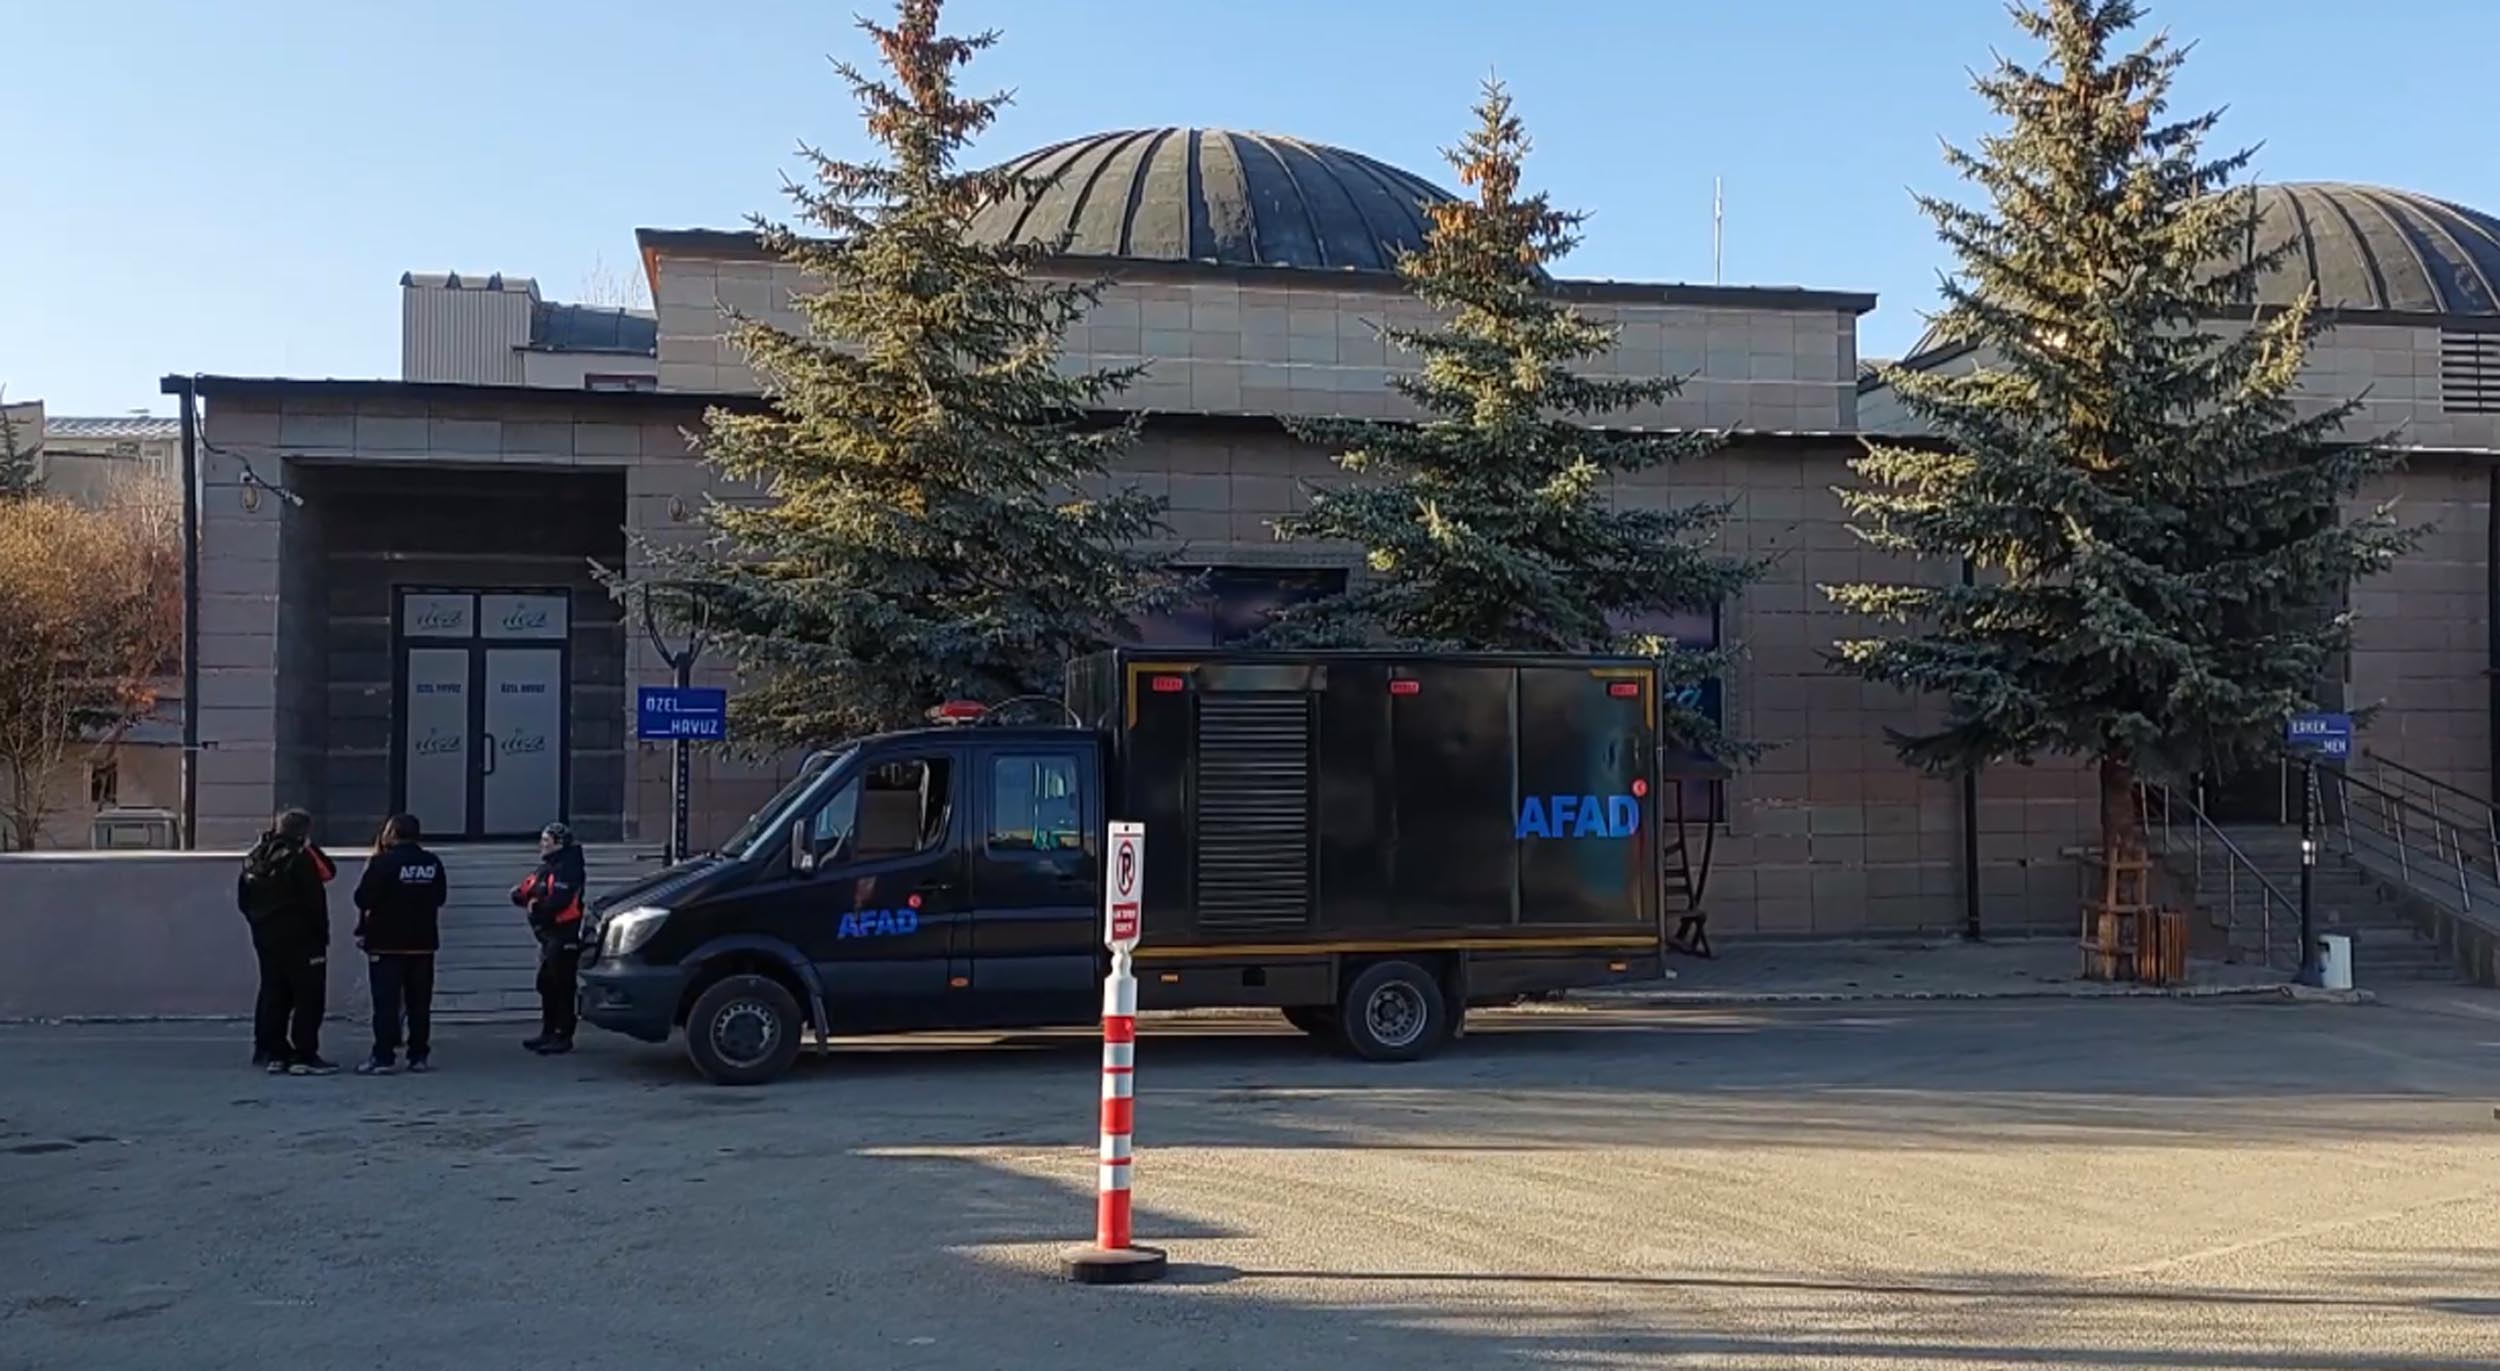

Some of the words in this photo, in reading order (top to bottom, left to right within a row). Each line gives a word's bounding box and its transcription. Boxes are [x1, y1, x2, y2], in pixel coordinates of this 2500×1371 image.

[645, 696, 680, 713] ÖZEL
[671, 718, 718, 735] HAVUZ
[1514, 794, 1640, 839] AFAD
[399, 864, 436, 880] AFAD
[837, 907, 919, 940] AFAD
